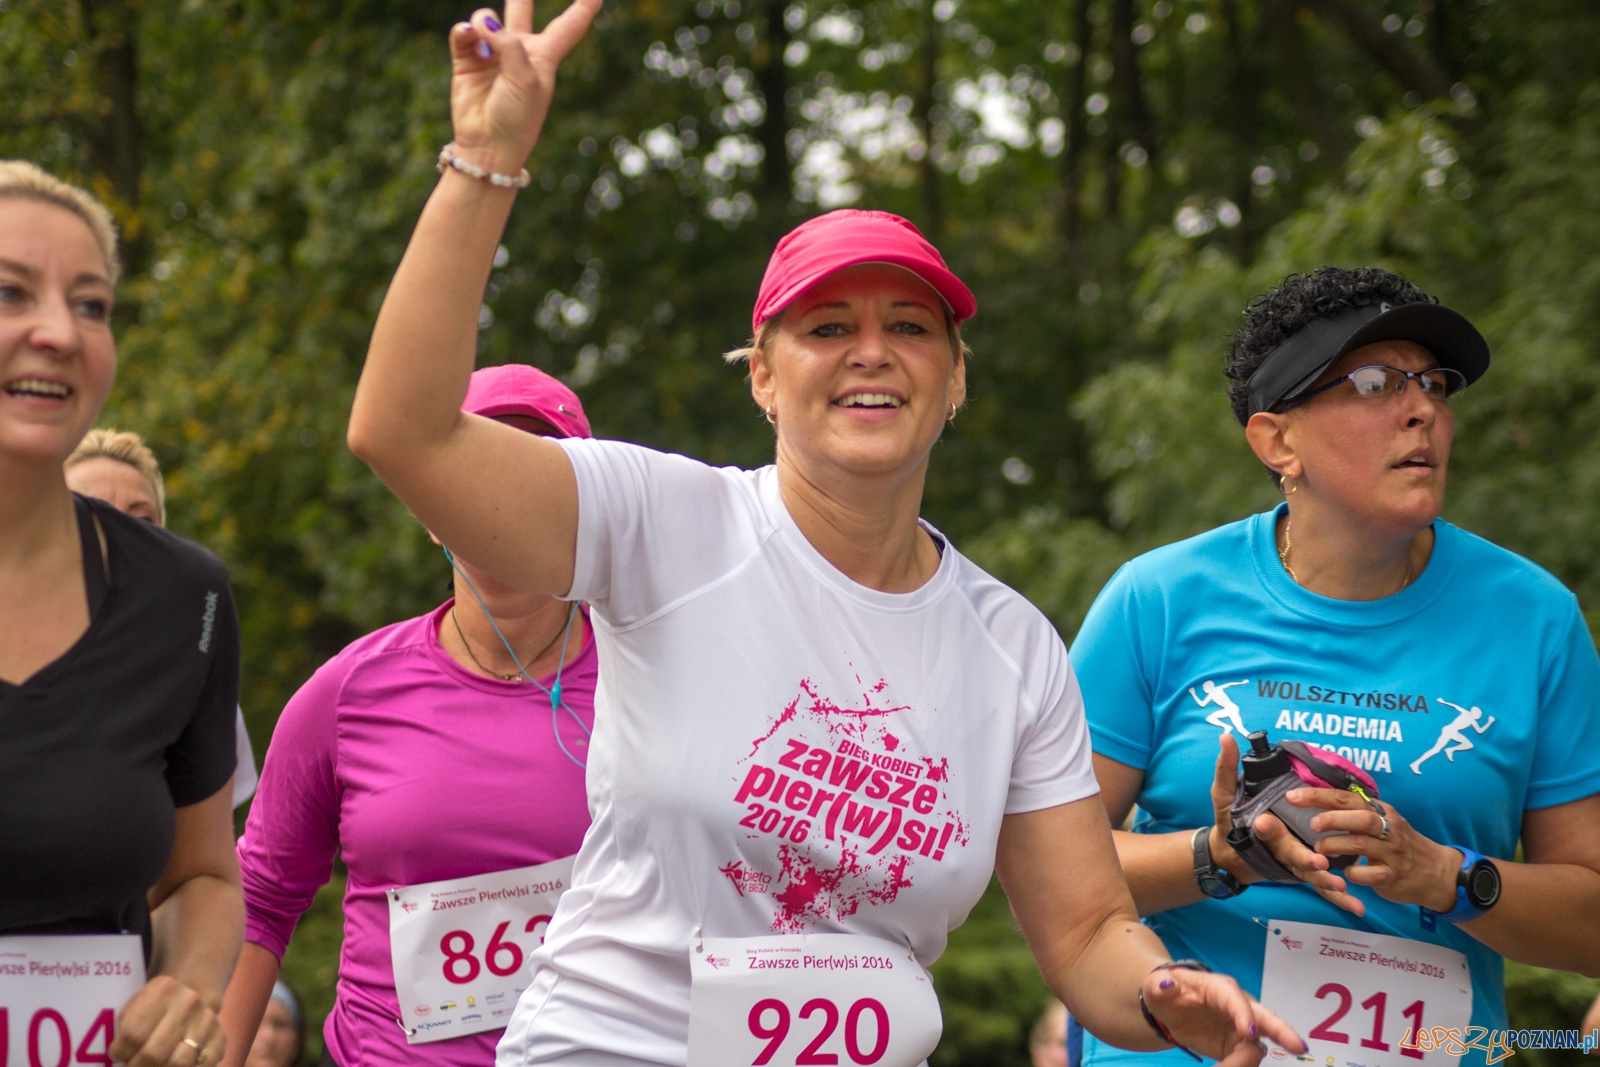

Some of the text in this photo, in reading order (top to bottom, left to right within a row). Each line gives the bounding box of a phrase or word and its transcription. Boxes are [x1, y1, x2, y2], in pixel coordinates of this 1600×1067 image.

[199, 591, 219, 653] Reebok
[1257, 679, 1429, 713] WOLSZTYŃSKA
[1275, 709, 1403, 743] AKADEMIA
[777, 738, 938, 814] zawsze
[837, 739, 923, 779] BIEG KOBIET
[733, 764, 955, 862] pier(w)si!
[739, 803, 811, 843] 2016
[432, 896, 476, 911] Zawsze
[479, 886, 529, 902] Pier(w)si
[532, 878, 563, 894] 2016
[29, 961, 90, 978] Pier(w)si
[94, 961, 132, 976] 2016
[748, 955, 893, 971] Zawsze Pier(w)si 2016
[1319, 943, 1446, 979] Zawsze Pier(w)si 2016
[747, 997, 890, 1066] 920
[1308, 982, 1426, 1061] 211
